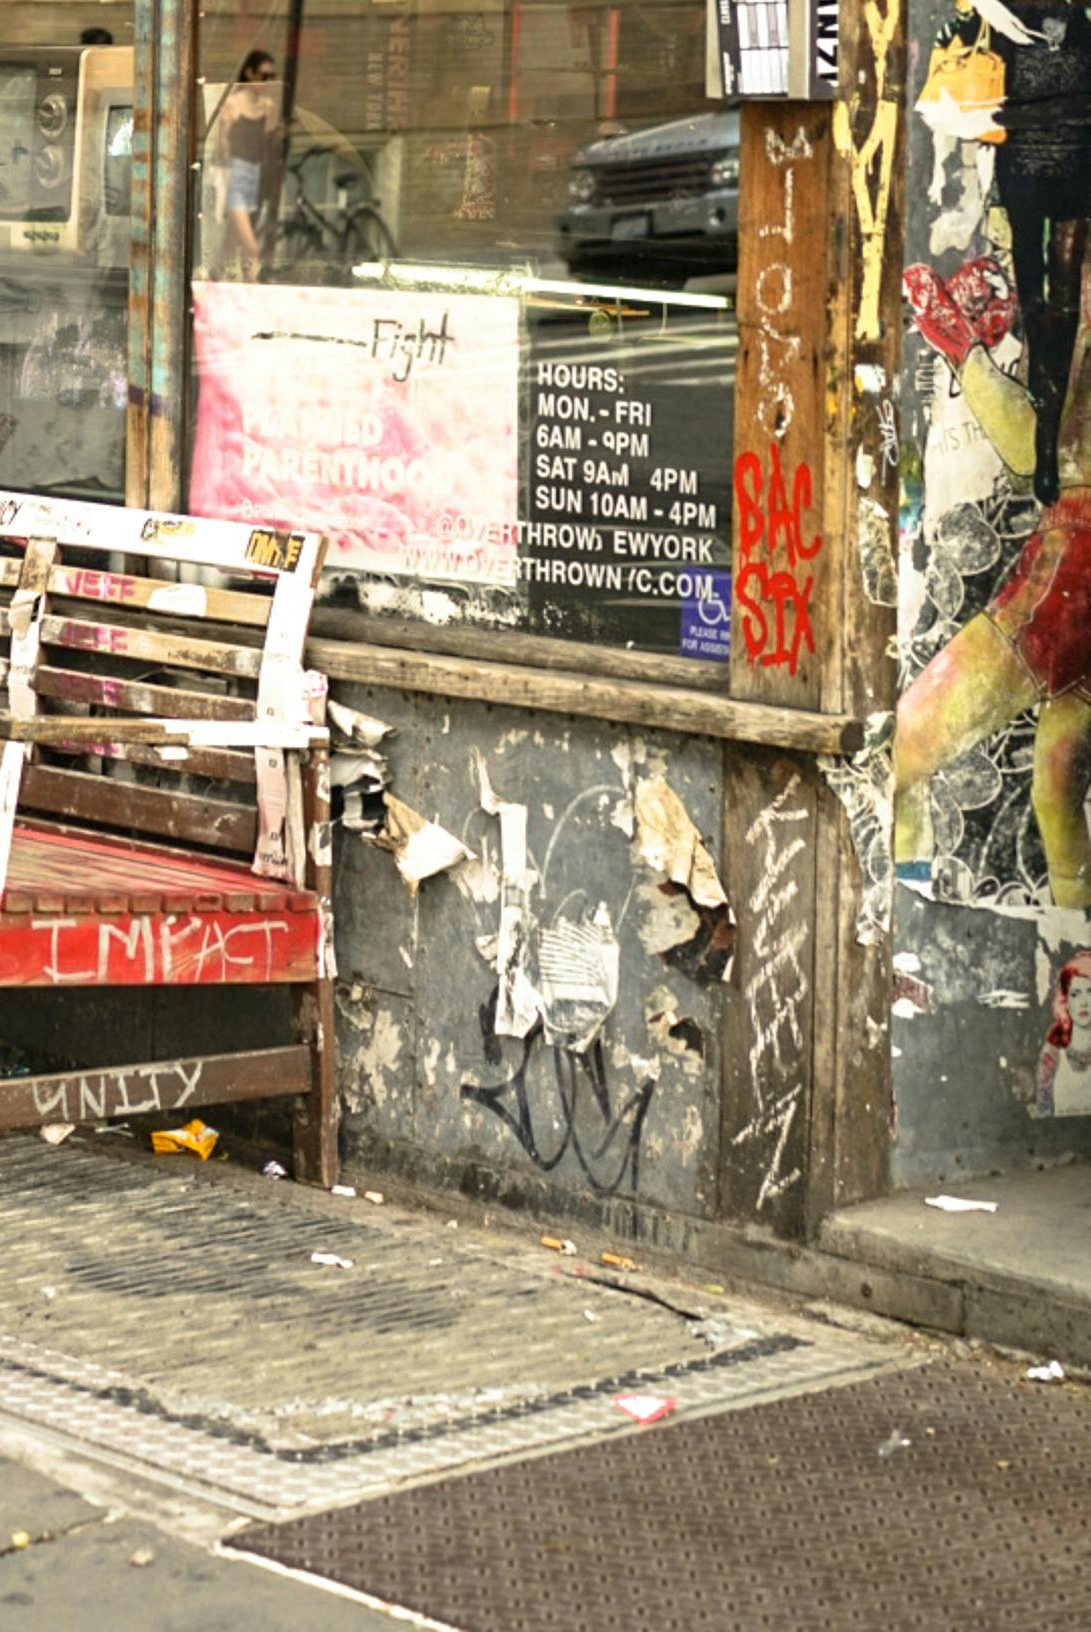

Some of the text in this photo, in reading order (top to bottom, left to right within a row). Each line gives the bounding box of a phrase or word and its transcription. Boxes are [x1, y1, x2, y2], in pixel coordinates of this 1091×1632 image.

[370, 310, 455, 383] Fight
[537, 362, 625, 394] HOURS:
[614, 400, 652, 427] FRI
[536, 423, 582, 451] 6AM
[602, 431, 650, 458] 9PM
[536, 454, 698, 495] SAT 9AM 4PM
[535, 485, 583, 514] SUN
[590, 491, 648, 521] 10AM
[668, 501, 717, 529] 4PM
[735, 562, 815, 678] SIX
[30, 915, 292, 985] IMPACT
[27, 1059, 205, 1121] UNITY
